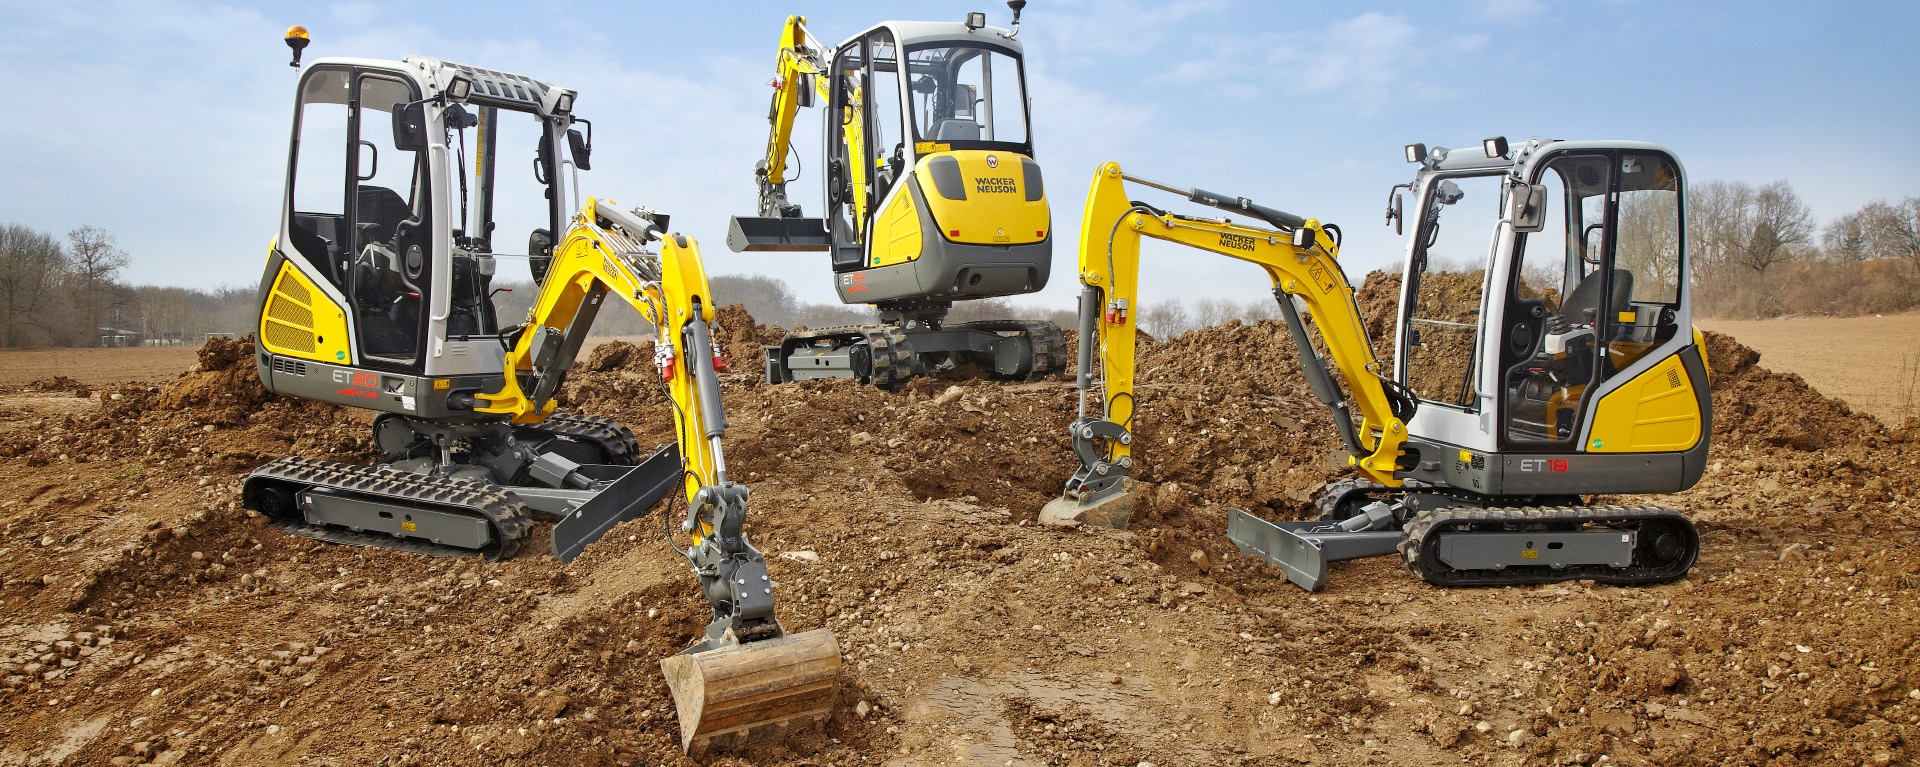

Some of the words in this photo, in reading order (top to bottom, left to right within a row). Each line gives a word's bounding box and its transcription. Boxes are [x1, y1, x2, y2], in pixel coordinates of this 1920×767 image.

[975, 177, 1016, 186] WACKER
[977, 185, 1017, 194] NEUSON
[1219, 239, 1256, 252] NEUSON
[1220, 232, 1256, 246] WACKER
[332, 369, 379, 388] ET20
[1520, 459, 1569, 473] ET18
